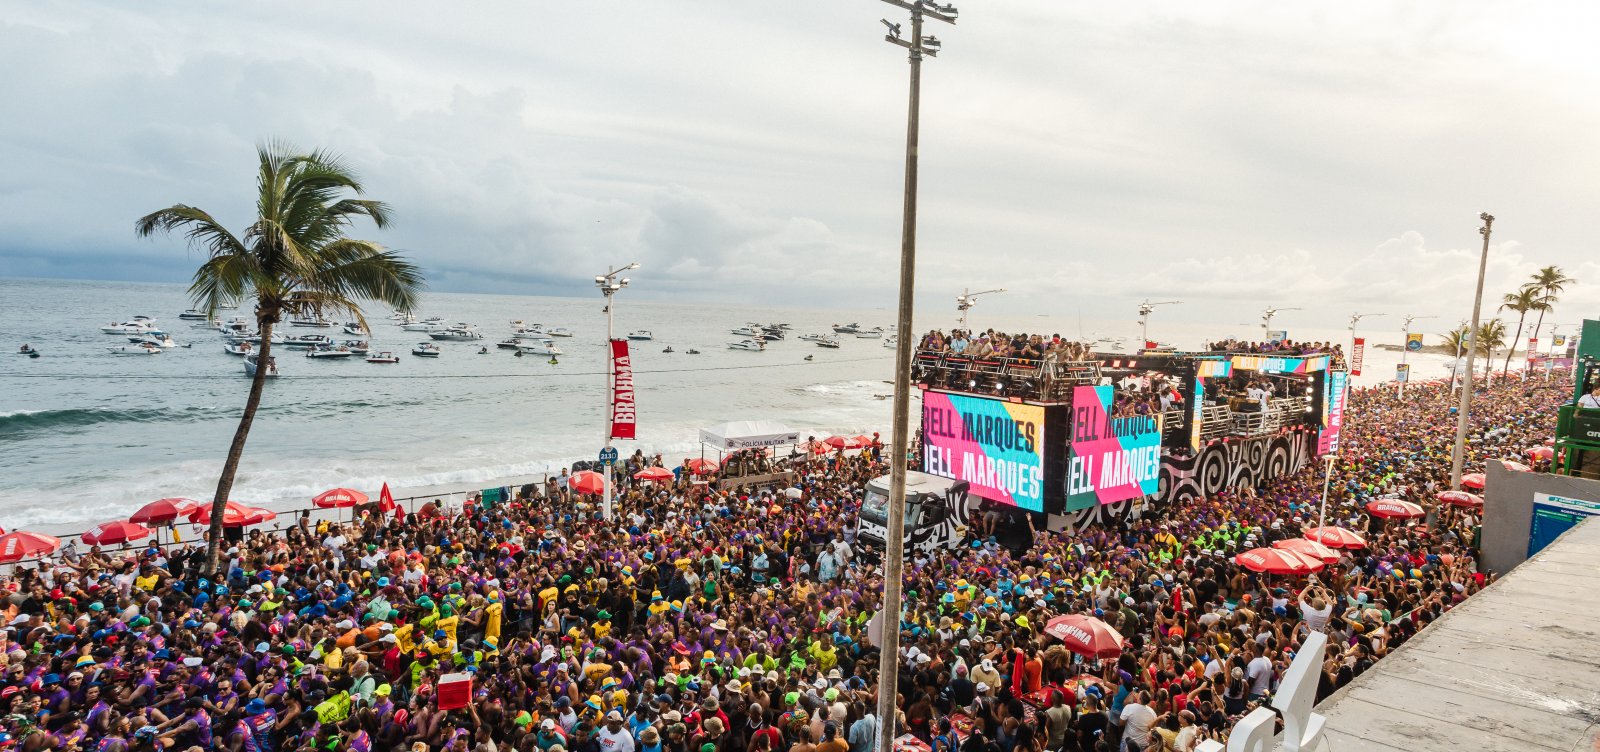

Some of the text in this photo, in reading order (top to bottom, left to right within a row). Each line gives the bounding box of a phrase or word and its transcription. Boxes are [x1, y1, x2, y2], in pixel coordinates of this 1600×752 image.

[614, 355, 635, 423] BRAHMA
[961, 411, 1035, 453] MARQUES
[962, 451, 1040, 499] MARQUES
[1067, 444, 1160, 496] ELL MARQUES
[1377, 504, 1405, 514] BRAHMA
[1054, 623, 1092, 646] BRAHMA
